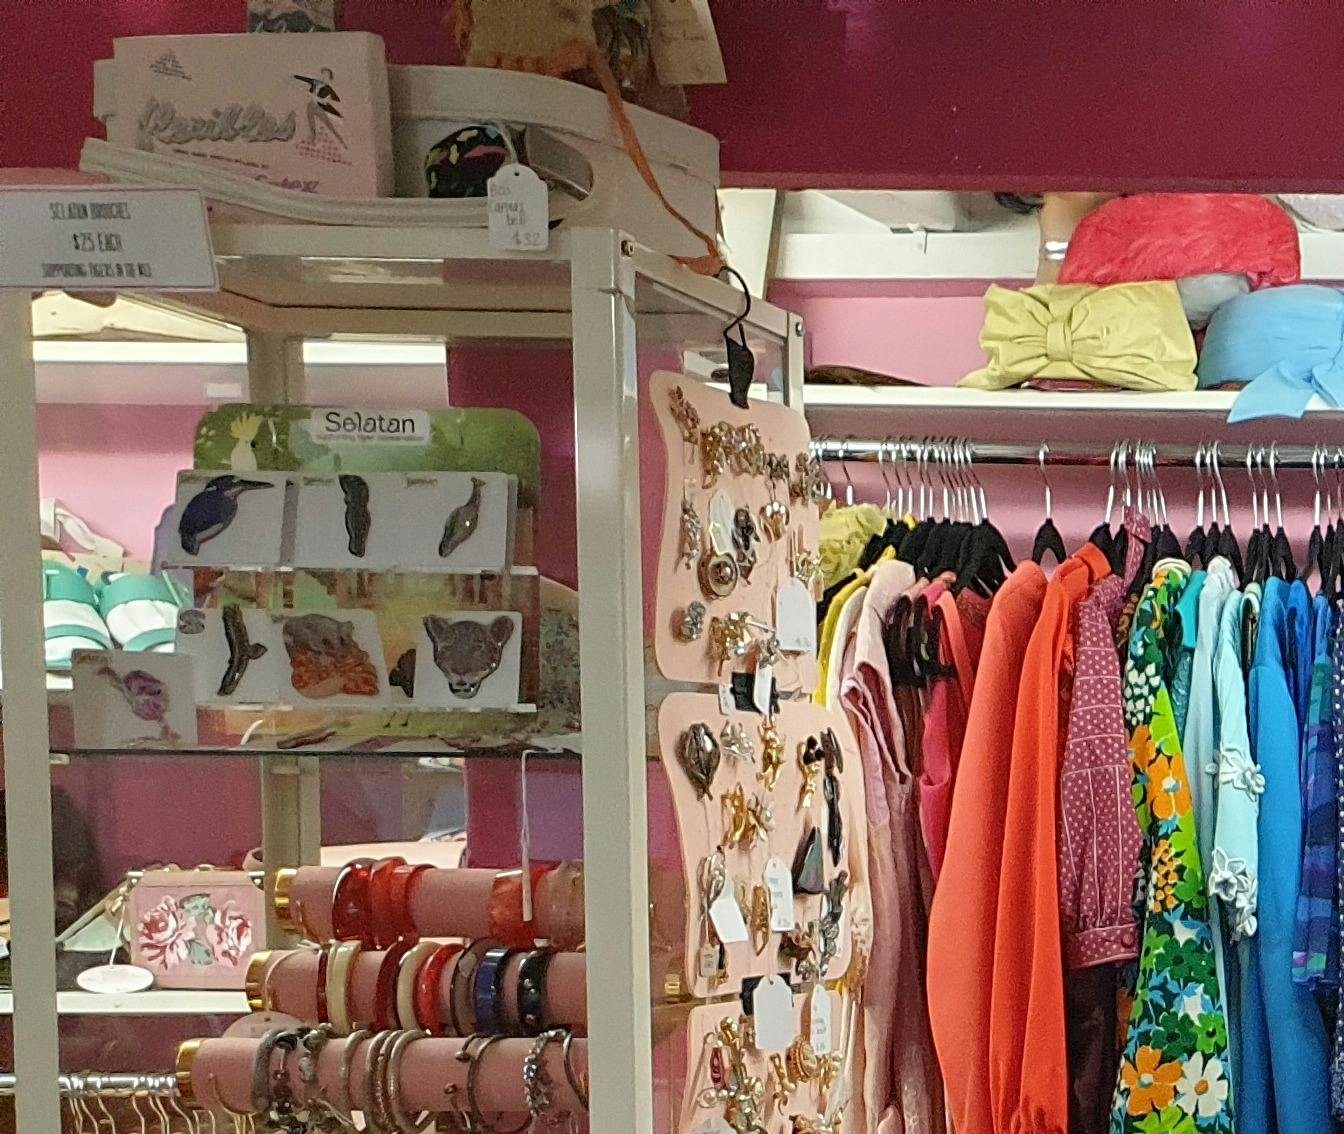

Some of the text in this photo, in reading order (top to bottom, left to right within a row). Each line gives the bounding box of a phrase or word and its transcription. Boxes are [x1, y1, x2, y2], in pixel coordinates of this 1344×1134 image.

[50, 202, 88, 220] SELATAN
[73, 232, 123, 251] $25 EACH
[325, 411, 415, 434] Selatan
